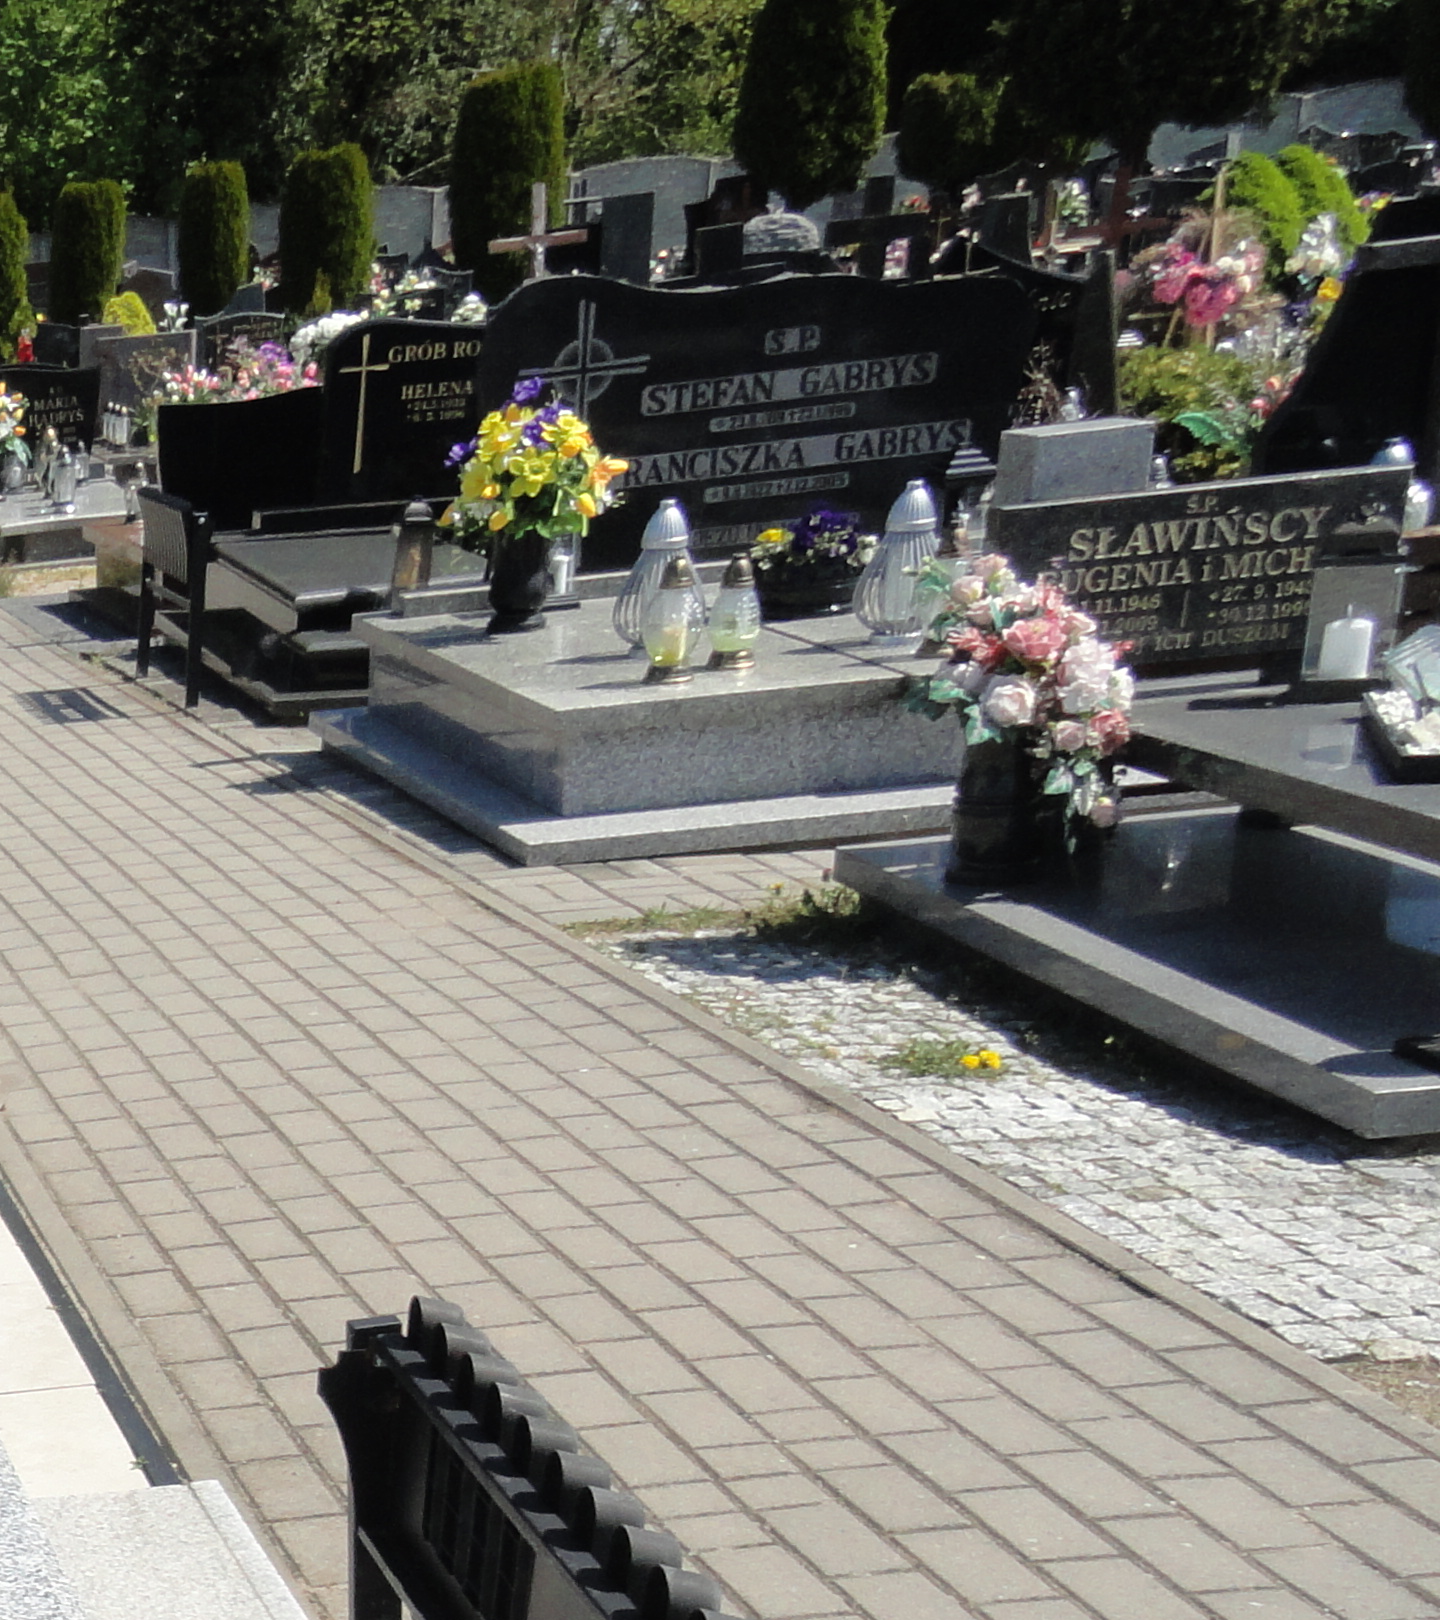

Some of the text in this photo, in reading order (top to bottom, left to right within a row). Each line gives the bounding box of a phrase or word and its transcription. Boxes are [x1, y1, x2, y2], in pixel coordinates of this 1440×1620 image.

[388, 339, 446, 363] GRÓB
[401, 380, 474, 400] HELENA
[644, 372, 775, 414] STEFAN
[619, 442, 806, 488] RANCISZKA
[1069, 505, 1331, 562] SŁAWIŃSCY
